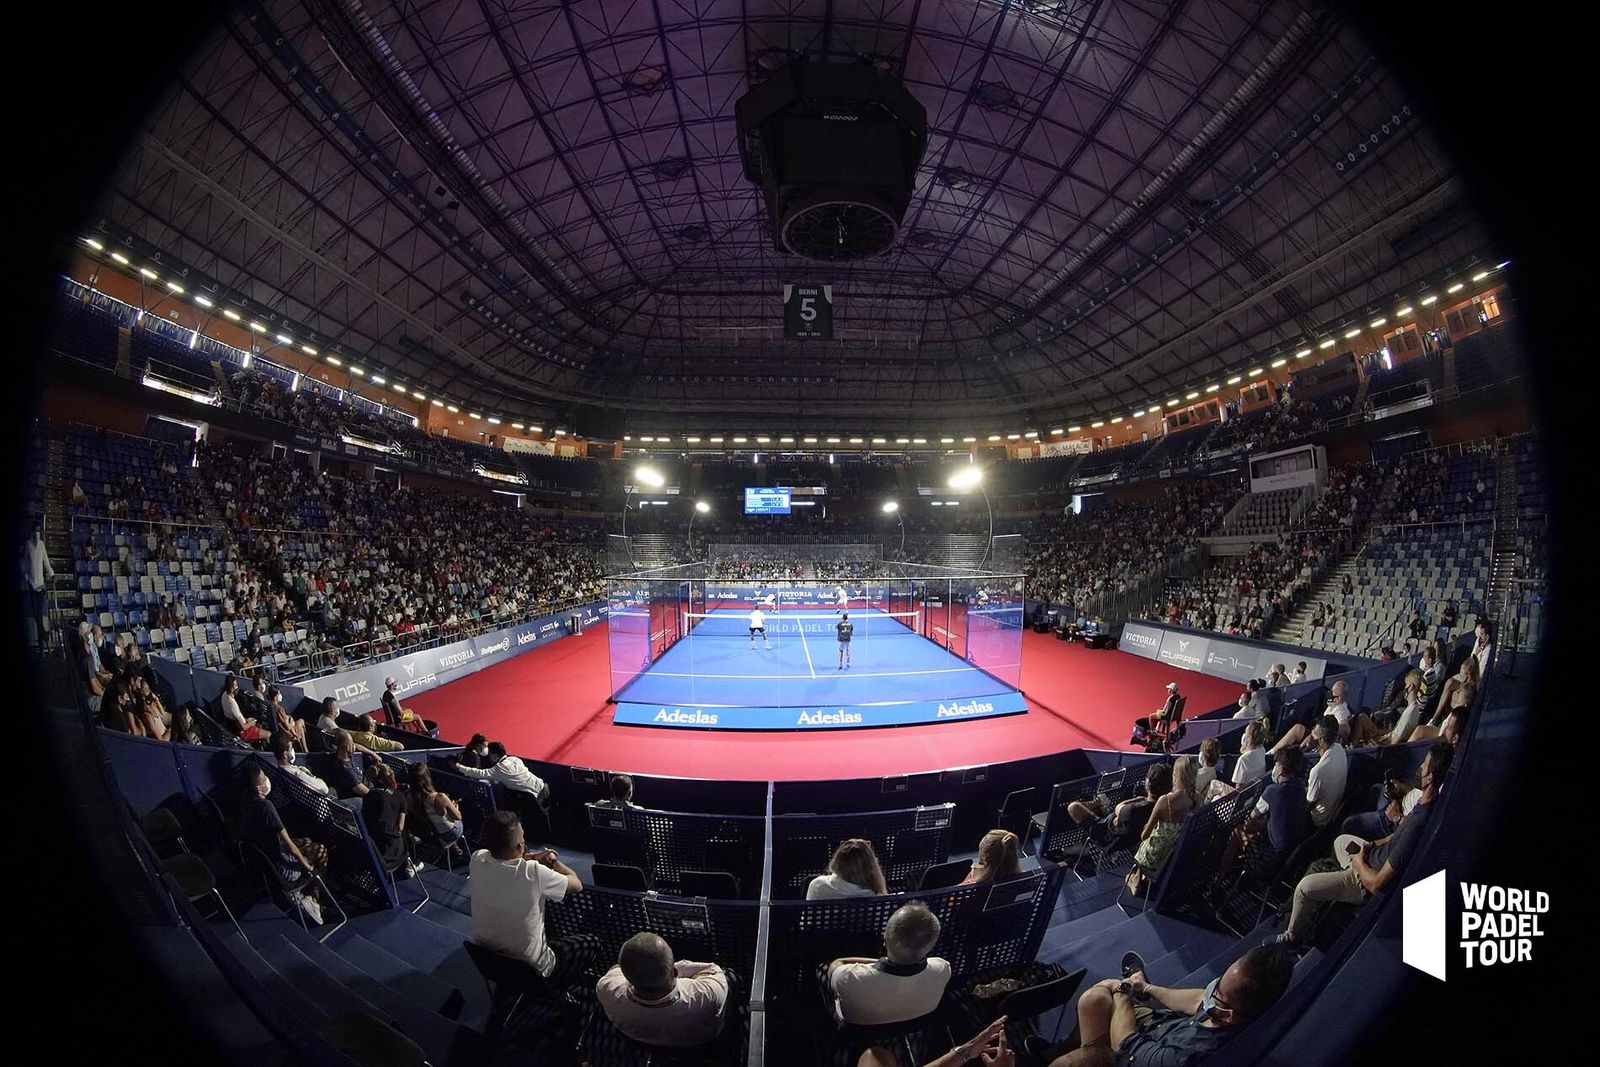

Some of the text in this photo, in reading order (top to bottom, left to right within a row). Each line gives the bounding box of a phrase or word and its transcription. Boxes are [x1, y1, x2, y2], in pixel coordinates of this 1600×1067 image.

[800, 298, 817, 321] 5
[1125, 631, 1156, 647] VICTORIA
[440, 649, 475, 667] VICTORIA
[1161, 651, 1200, 666] CUPRA
[654, 708, 718, 725] Adeslas
[797, 709, 862, 724] Adeslas
[937, 700, 994, 718] Adeslas
